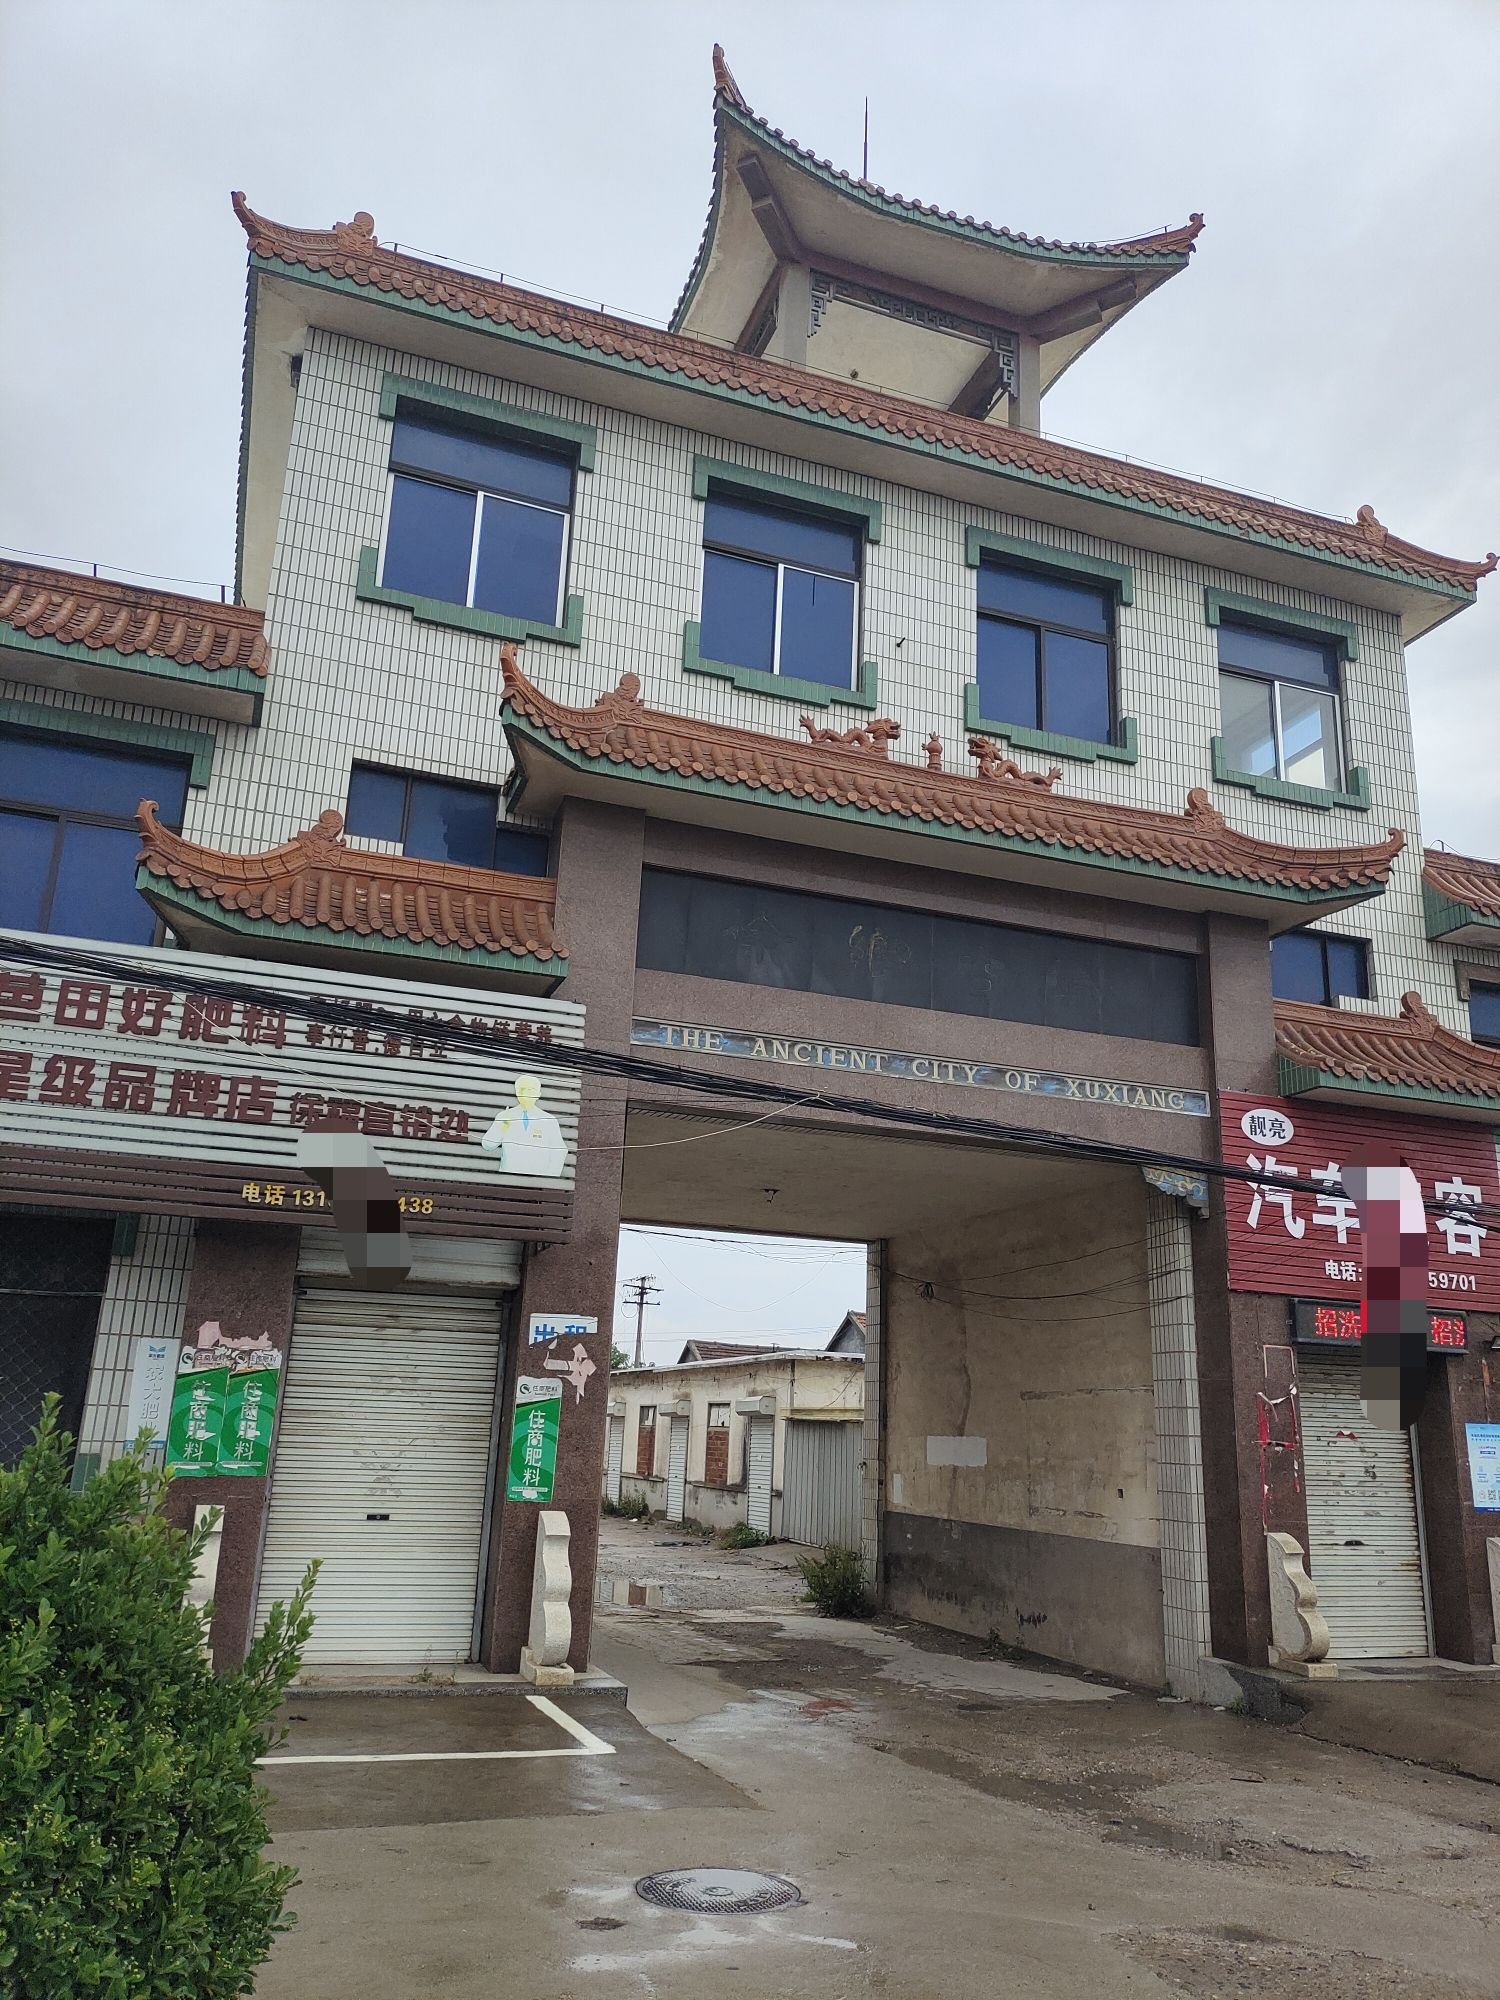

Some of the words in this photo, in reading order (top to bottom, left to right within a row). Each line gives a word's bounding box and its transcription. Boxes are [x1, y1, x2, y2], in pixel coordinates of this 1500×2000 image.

[659, 1024, 723, 1052] THE
[749, 1039, 891, 1074] ANCIENT
[912, 1058, 981, 1085] CITY
[1005, 1070, 1039, 1093] OF
[1065, 1080, 1186, 1110] XUXIANG
[1248, 1115, 1287, 1140] 靓亮
[241, 1182, 286, 1207] 电话
[1245, 1152, 1488, 1259] 汽车容
[522, 1409, 546, 1487] 住商肥料
